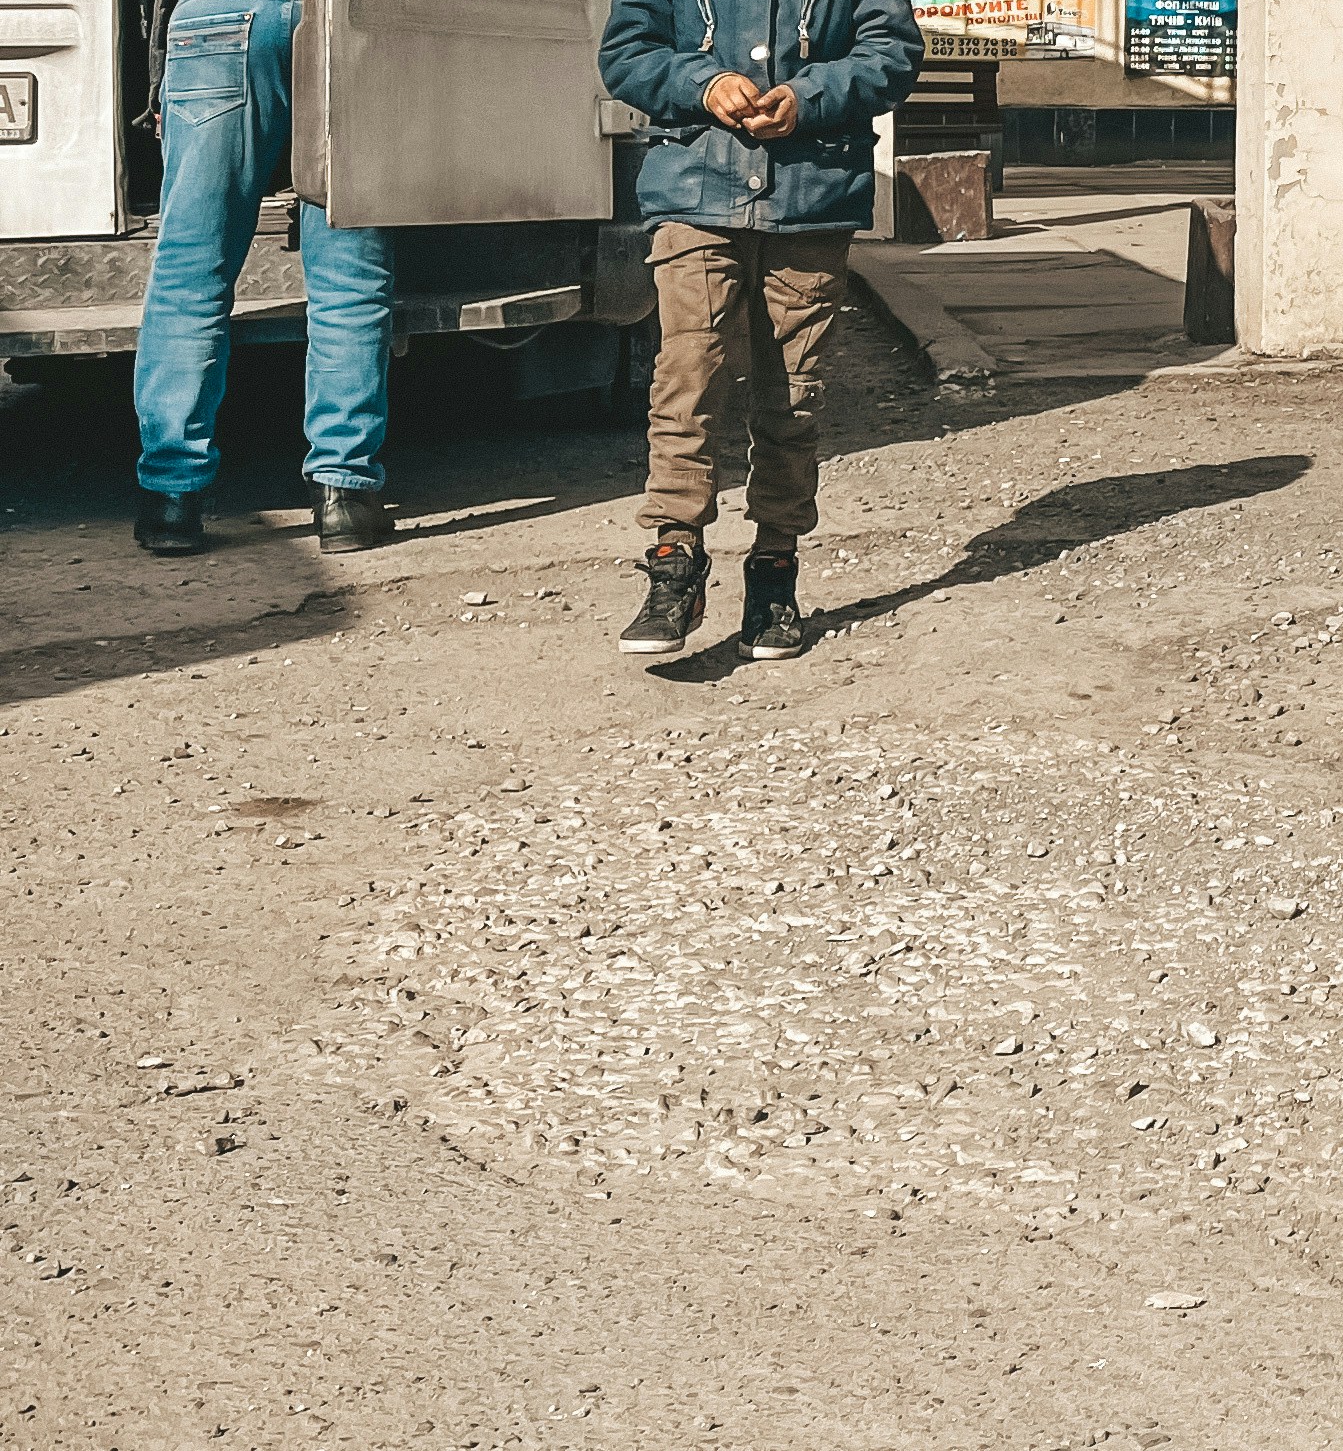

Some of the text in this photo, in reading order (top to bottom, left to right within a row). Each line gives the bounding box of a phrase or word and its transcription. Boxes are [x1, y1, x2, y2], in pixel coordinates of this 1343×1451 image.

[1155, 0, 1219, 10] ФОП НЕМЕШ
[1149, 15, 1184, 25] ТЯЧІВ
[1195, 15, 1222, 26] КИЇВ
[932, 37, 954, 46] 050
[958, 37, 980, 47] 370
[984, 38, 998, 47] 70
[958, 47, 980, 57] 370
